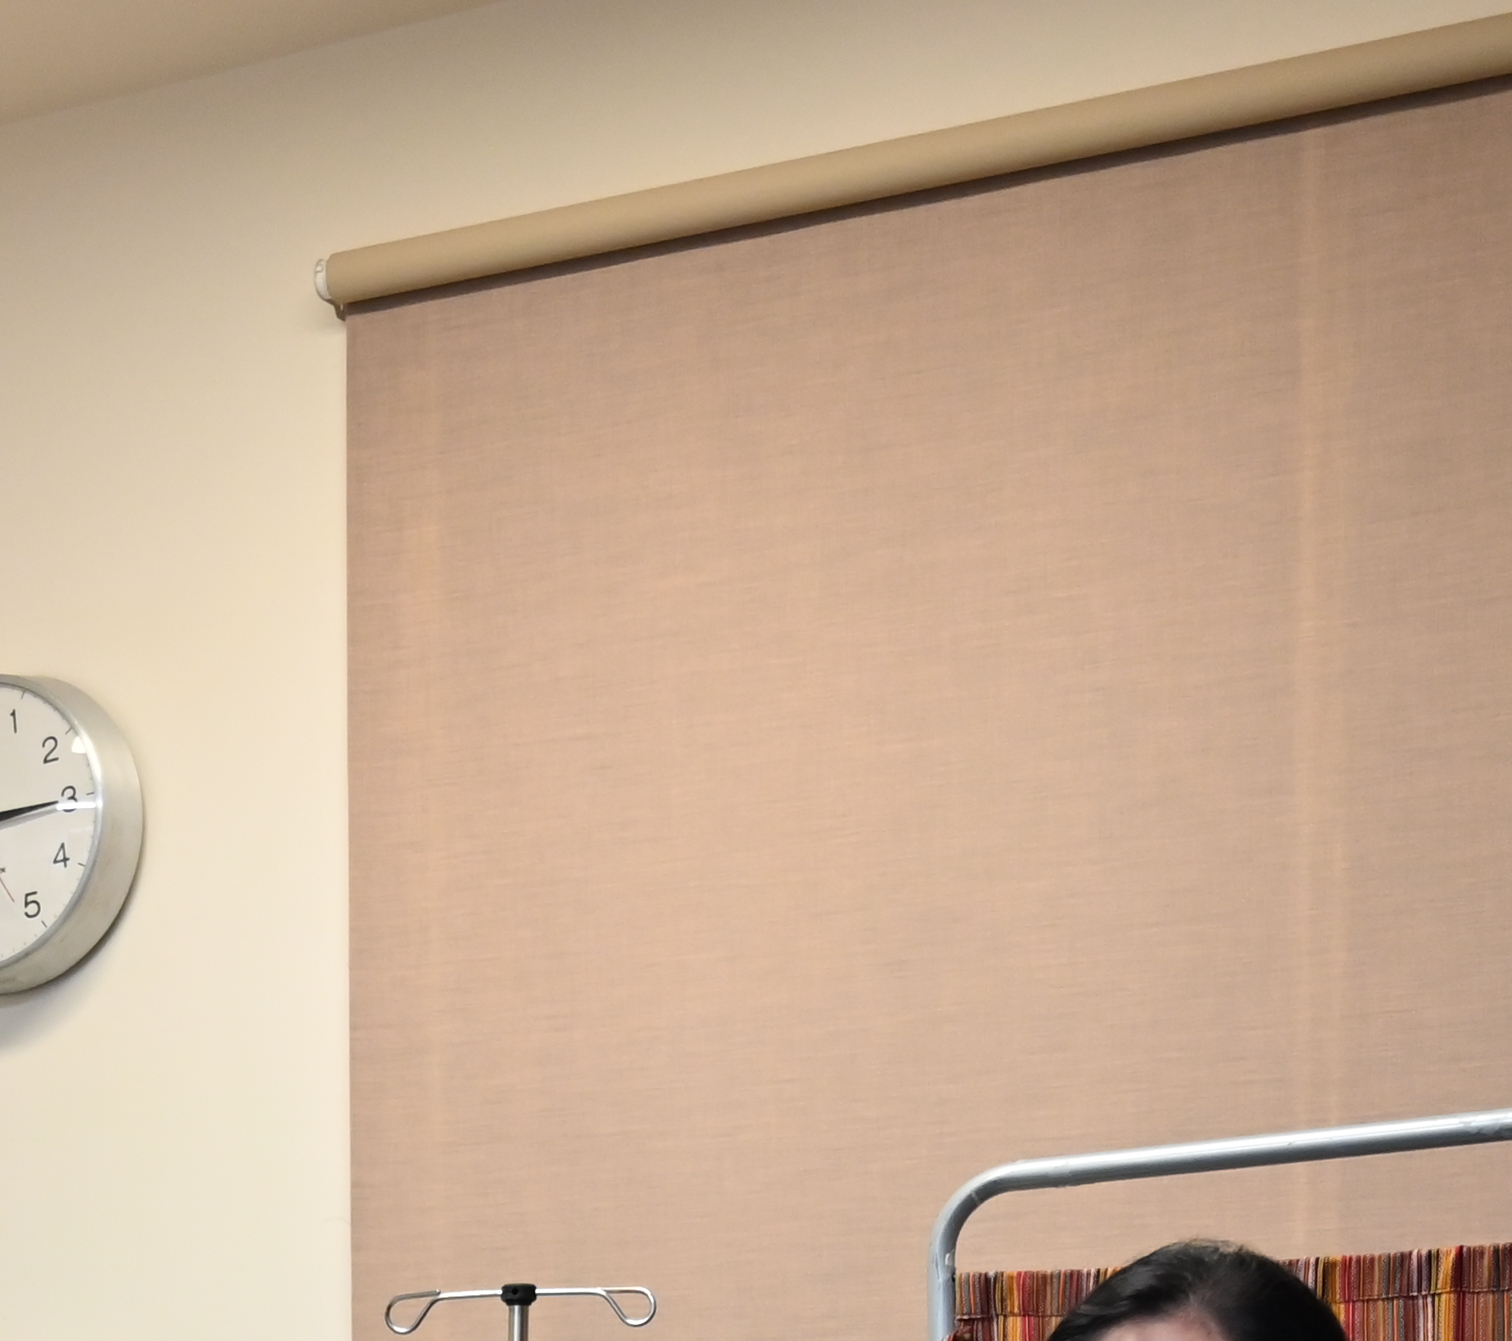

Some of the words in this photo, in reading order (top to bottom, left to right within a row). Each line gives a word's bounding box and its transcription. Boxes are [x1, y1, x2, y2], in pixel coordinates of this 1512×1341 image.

[9, 709, 19, 734] 1
[42, 736, 60, 764] 2
[61, 785, 78, 813] 3
[53, 842, 71, 868] 4
[23, 891, 42, 919] 5
